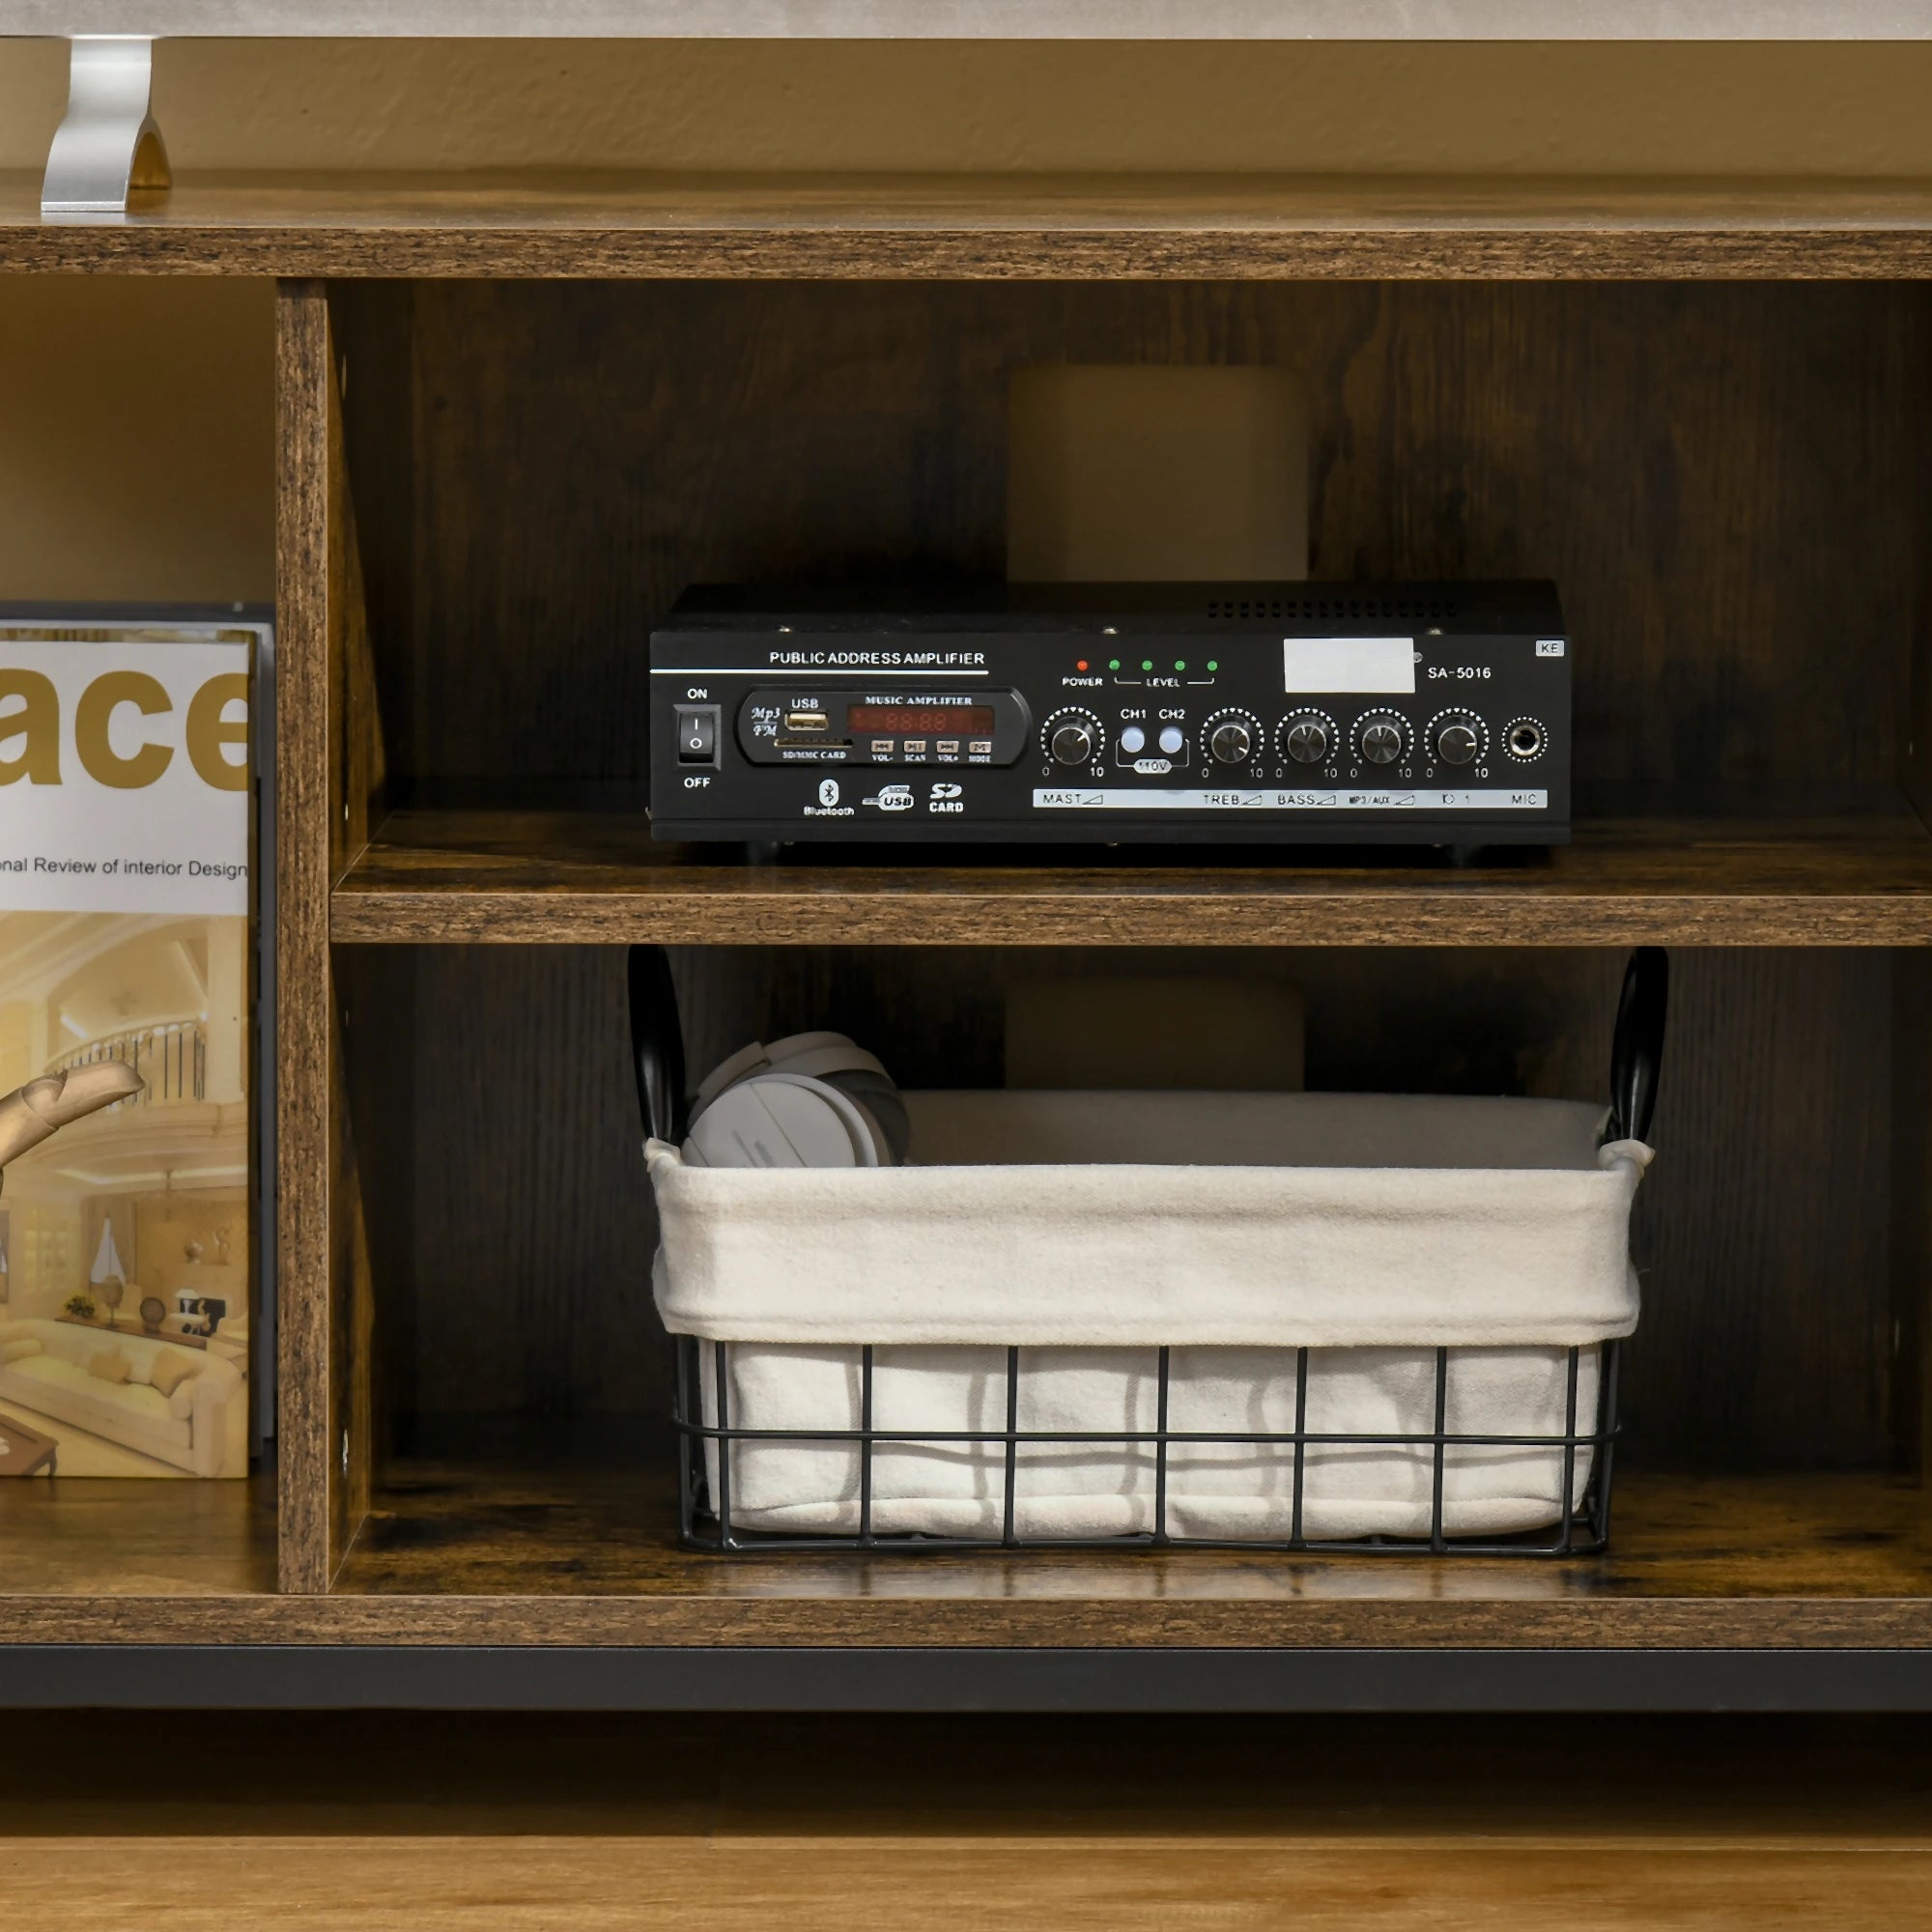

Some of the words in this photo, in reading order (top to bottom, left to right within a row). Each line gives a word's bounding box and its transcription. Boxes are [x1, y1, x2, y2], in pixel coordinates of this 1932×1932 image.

[769, 651, 824, 665] PUBLIC
[827, 652, 901, 665] ADDRESS
[903, 652, 984, 665] AMPLIFIER
[1428, 667, 1492, 679] SA-5016
[1062, 676, 1103, 687] POWER
[1146, 677, 1180, 687] LEVEL
[687, 688, 708, 699] ON
[791, 697, 819, 709] USB
[866, 696, 903, 705] MUSIC
[906, 696, 972, 705] AMPLIFIER
[1120, 708, 1147, 719] CH1
[1158, 708, 1186, 720] CH2
[820, 751, 847, 759] CARD
[1137, 760, 1169, 771] 110V
[1090, 766, 1105, 777] 10
[1201, 768, 1209, 779] 0
[1250, 768, 1264, 779] 10
[1275, 768, 1283, 779] 0
[1324, 768, 1338, 779] 10
[1350, 768, 1358, 779] 0
[1399, 768, 1412, 779] 10
[1426, 768, 1434, 779] 0
[1475, 768, 1489, 779] 10
[683, 777, 711, 789] OFF
[884, 796, 912, 808] USB
[1042, 793, 1080, 805] MAST
[1203, 794, 1239, 806] TREB
[1277, 794, 1316, 806] BASS
[1511, 794, 1538, 805] MIC
[803, 806, 855, 816] Bluetooth
[928, 802, 964, 813] CARD
[0, 856, 28, 872] nal
[34, 858, 97, 874] Review
[102, 859, 119, 874] of
[124, 859, 183, 876] interior
[188, 861, 248, 880] Design
